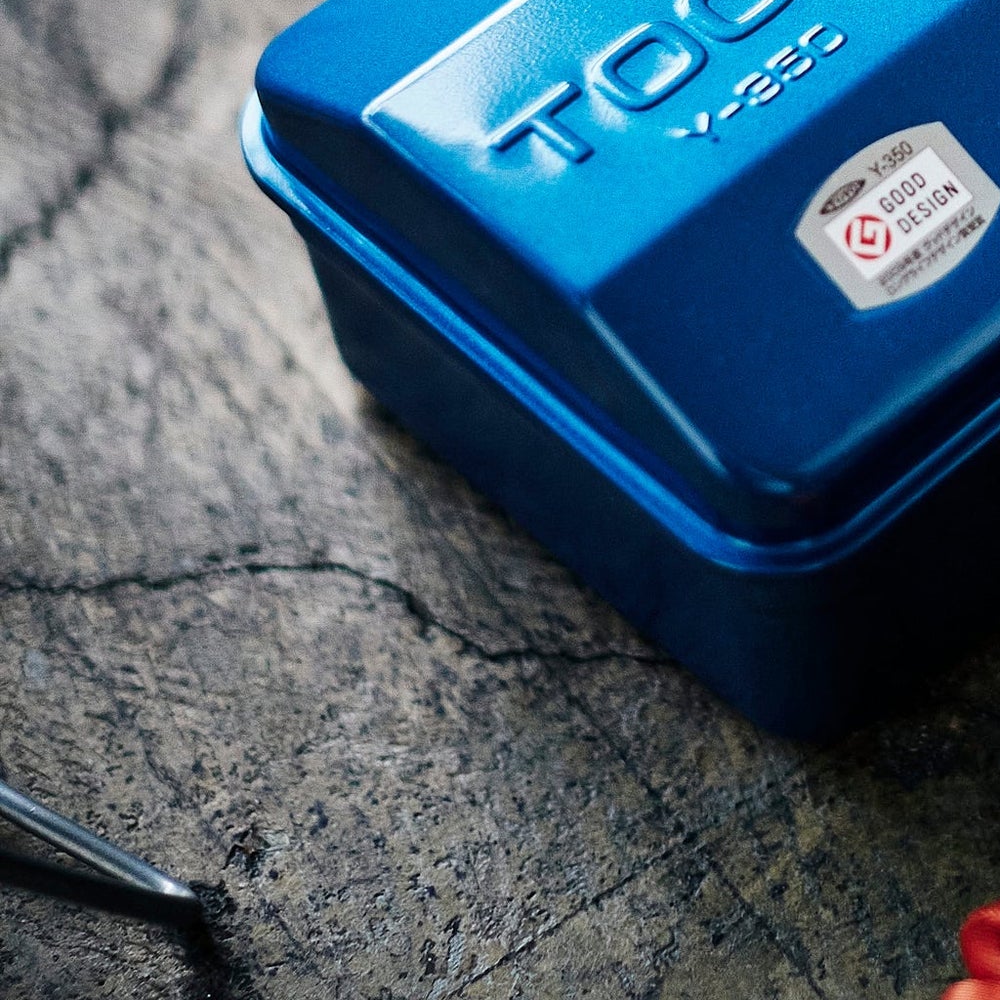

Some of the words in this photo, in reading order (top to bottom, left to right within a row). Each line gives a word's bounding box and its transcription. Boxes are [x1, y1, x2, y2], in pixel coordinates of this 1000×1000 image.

[666, 22, 849, 143] Y-350
[867, 139, 914, 179] Y-350
[879, 171, 927, 215] GOOD
[896, 179, 960, 235] DESIGN
